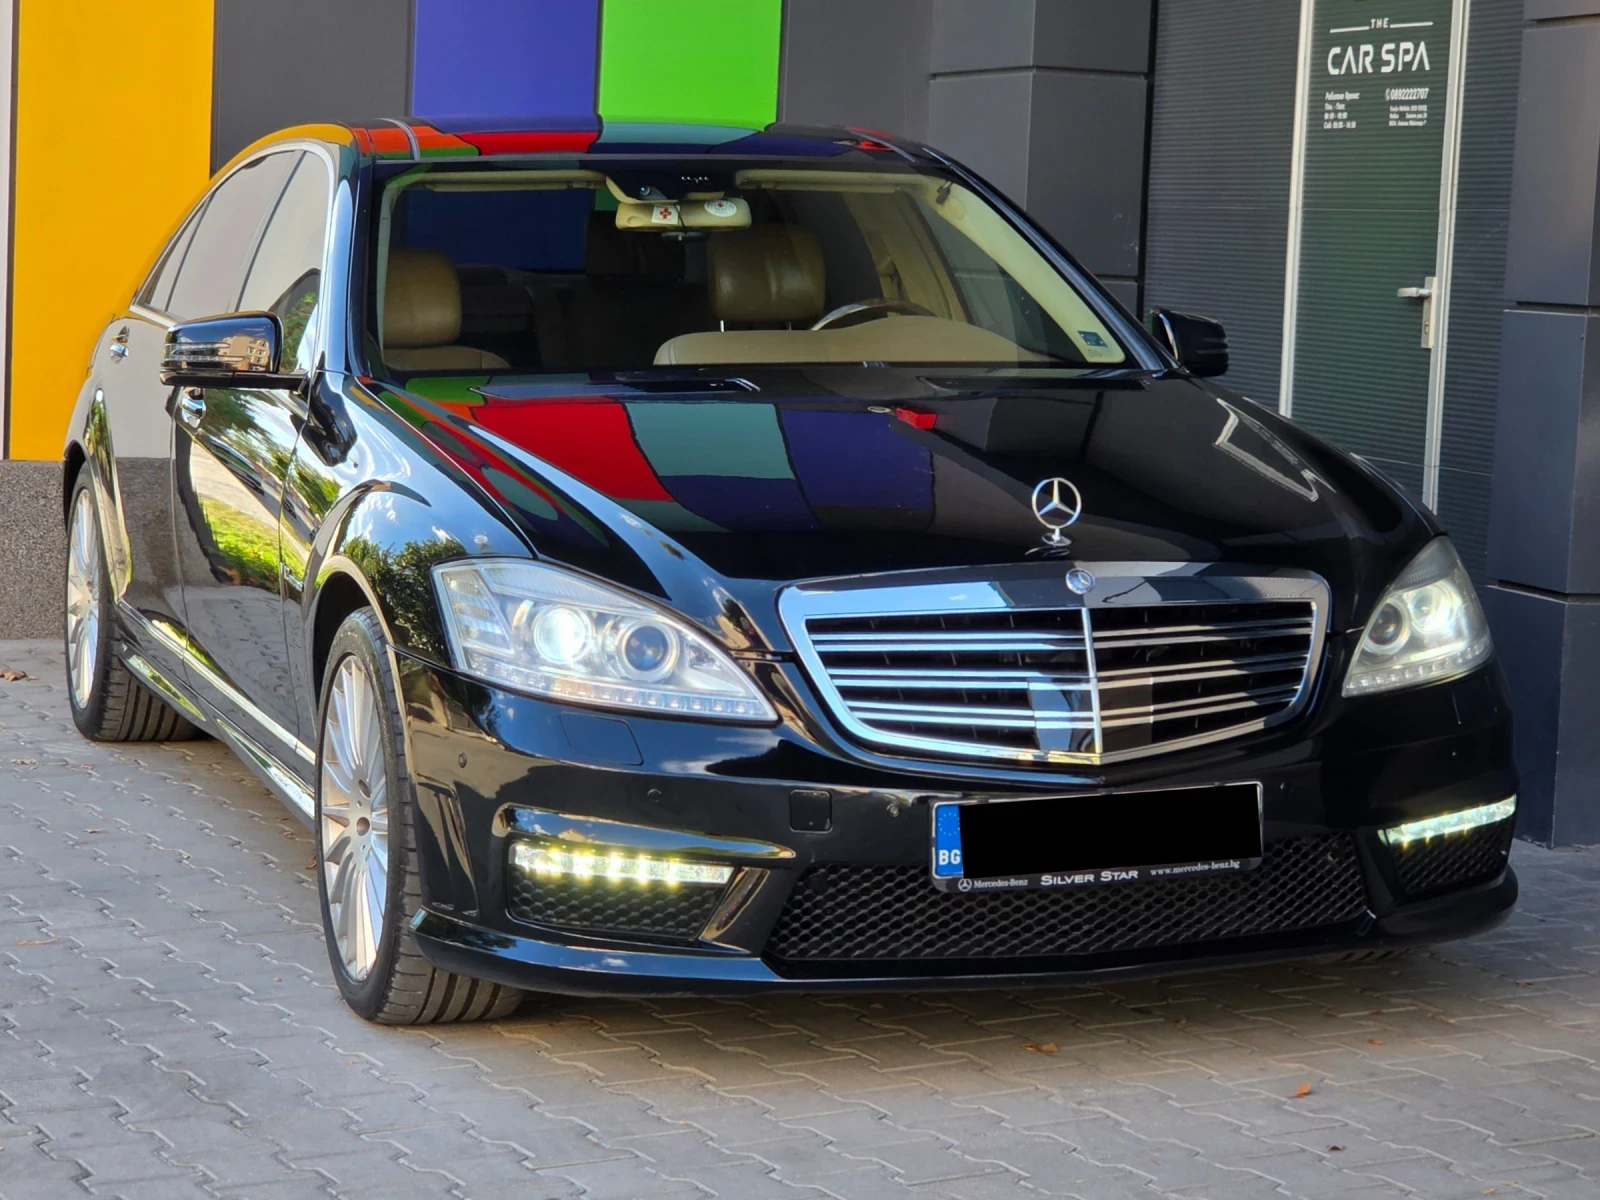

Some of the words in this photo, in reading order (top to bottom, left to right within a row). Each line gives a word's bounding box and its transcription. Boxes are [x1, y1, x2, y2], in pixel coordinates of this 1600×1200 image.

[1370, 17, 1390, 29] THE
[1327, 44, 1374, 76] CAR
[1380, 40, 1431, 73] SPA
[938, 849, 961, 866] BG
[973, 878, 1029, 889] Mercedes-Benz
[1040, 873, 1095, 886] SILVER
[1100, 870, 1139, 882] STAR
[1150, 859, 1241, 876] www.mercedes-benz.bg
